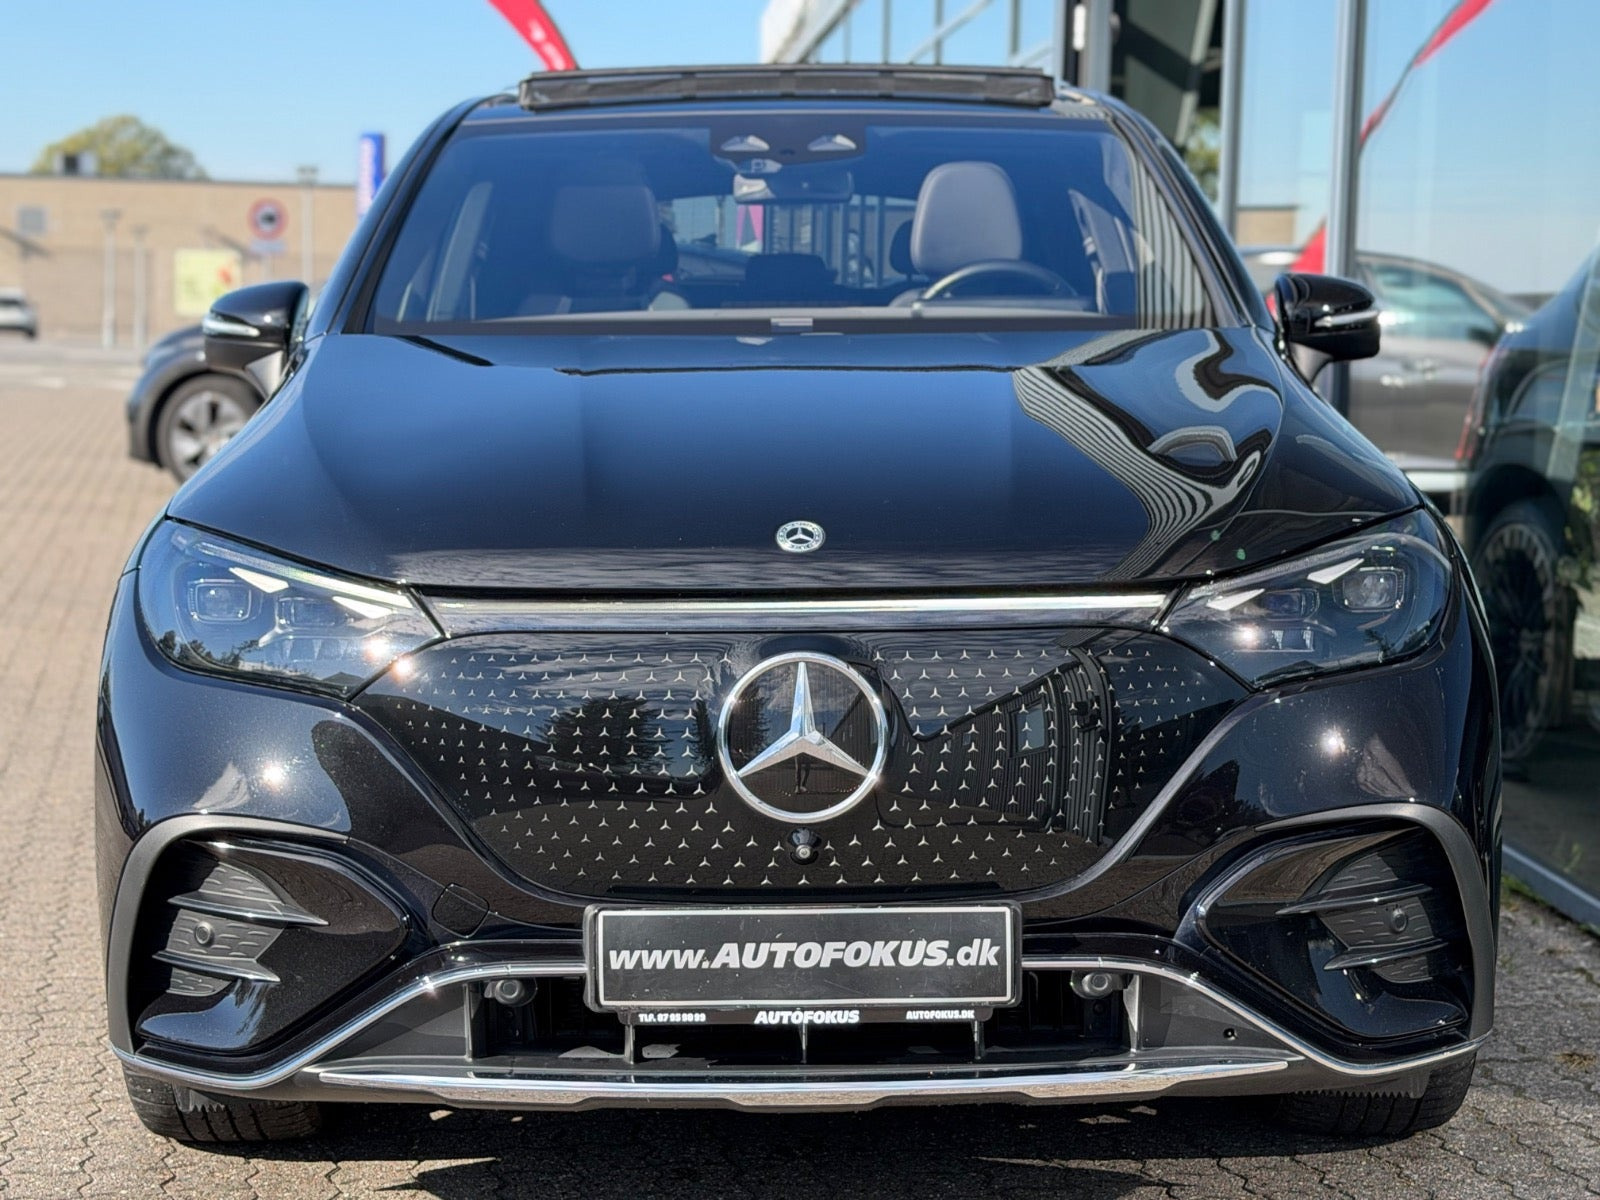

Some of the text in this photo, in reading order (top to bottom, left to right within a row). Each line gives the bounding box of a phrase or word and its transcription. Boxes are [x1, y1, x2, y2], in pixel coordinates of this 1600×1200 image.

[608, 938, 1000, 970] www.AUTOFOKUS.dk
[754, 1010, 860, 1024] AUTOFOKUS
[906, 1009, 975, 1020] AUTOFOKUS.DK
